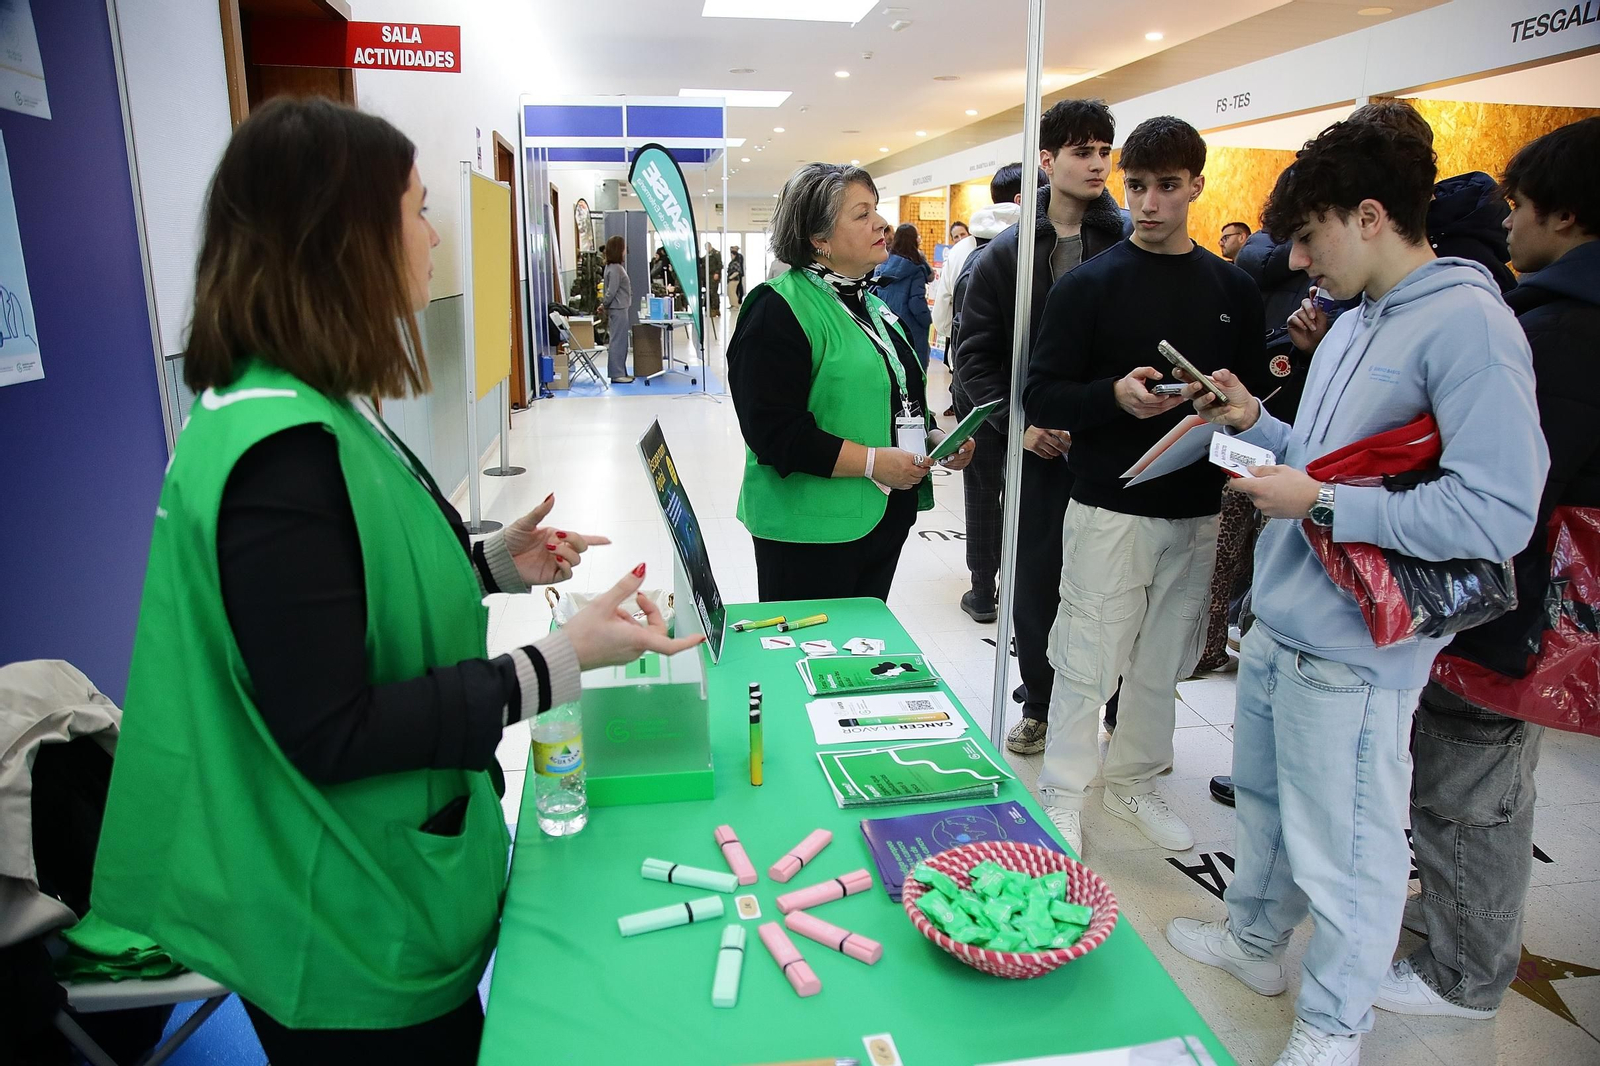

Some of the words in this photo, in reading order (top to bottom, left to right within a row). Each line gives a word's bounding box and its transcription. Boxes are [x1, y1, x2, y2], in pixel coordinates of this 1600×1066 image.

[381, 25, 422, 44] SALA
[353, 47, 455, 68] ACTIVIDADES
[1216, 97, 1228, 113] FS
[842, 725, 897, 735] FLAVOR
[899, 721, 954, 730] CANCER
